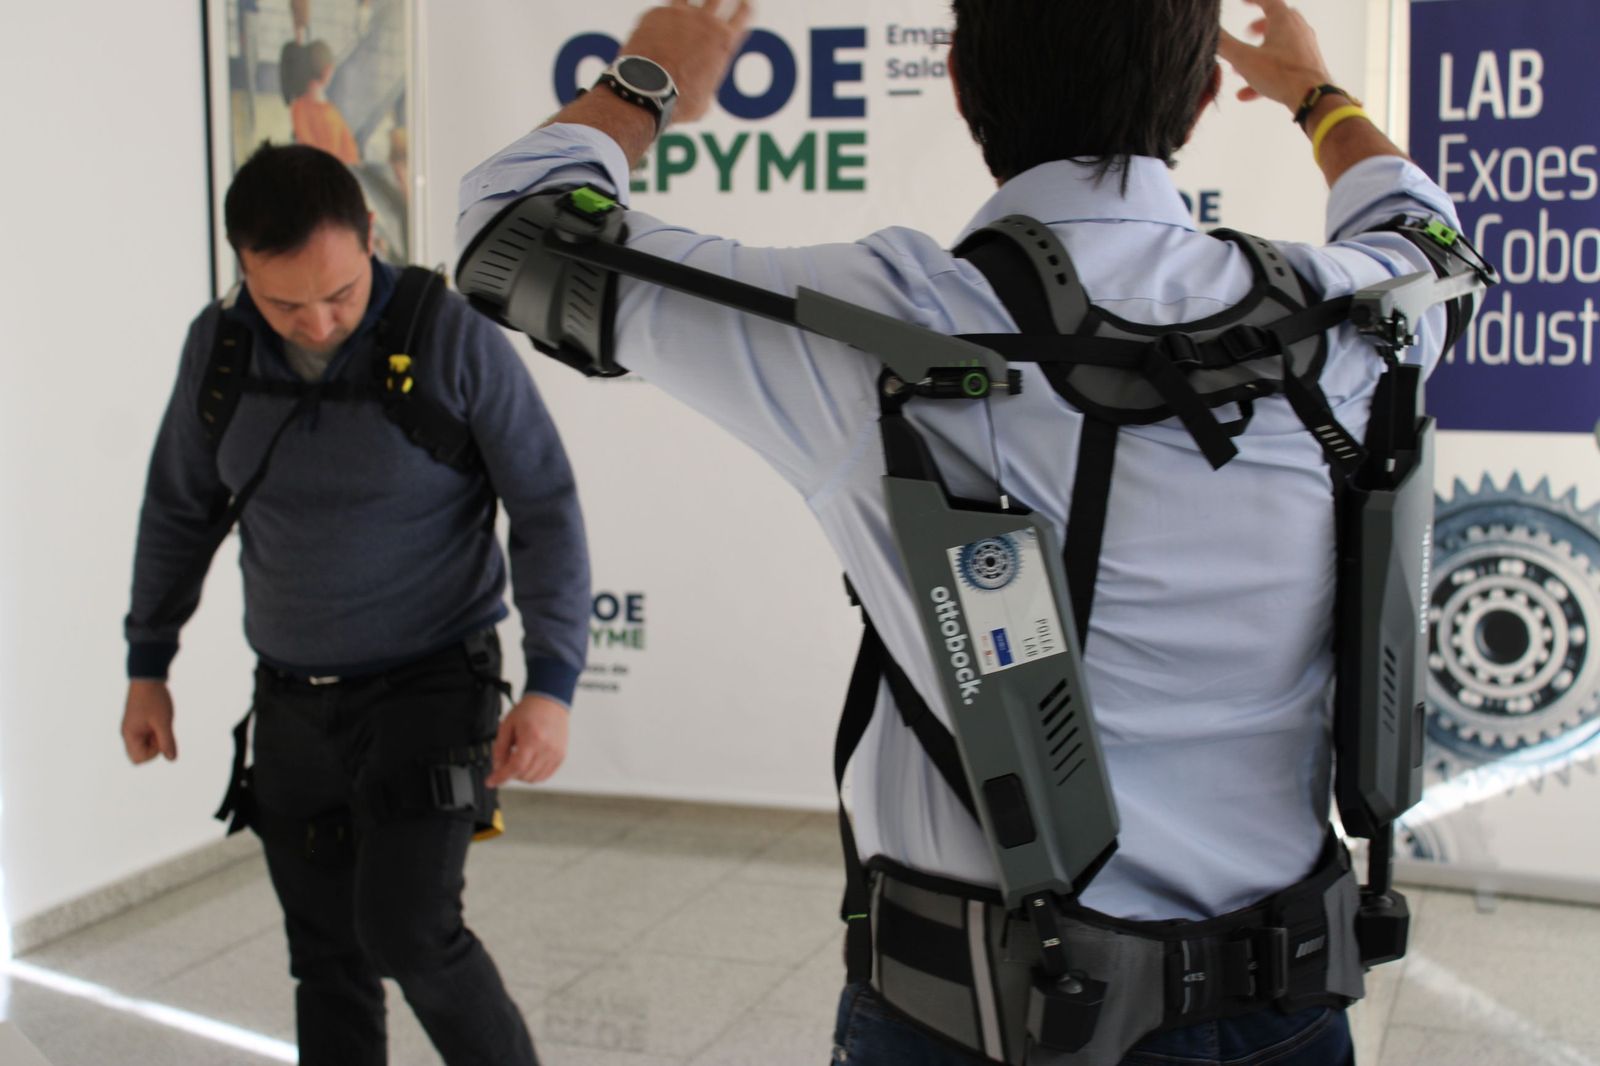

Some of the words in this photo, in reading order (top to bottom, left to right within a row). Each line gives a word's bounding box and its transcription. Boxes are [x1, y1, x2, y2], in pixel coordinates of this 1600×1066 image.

[553, 27, 867, 121] COE
[1439, 49, 1544, 121] LAB
[1438, 133, 1599, 203] Exoes
[1177, 189, 1221, 223] E
[930, 585, 983, 706] ottobock.
